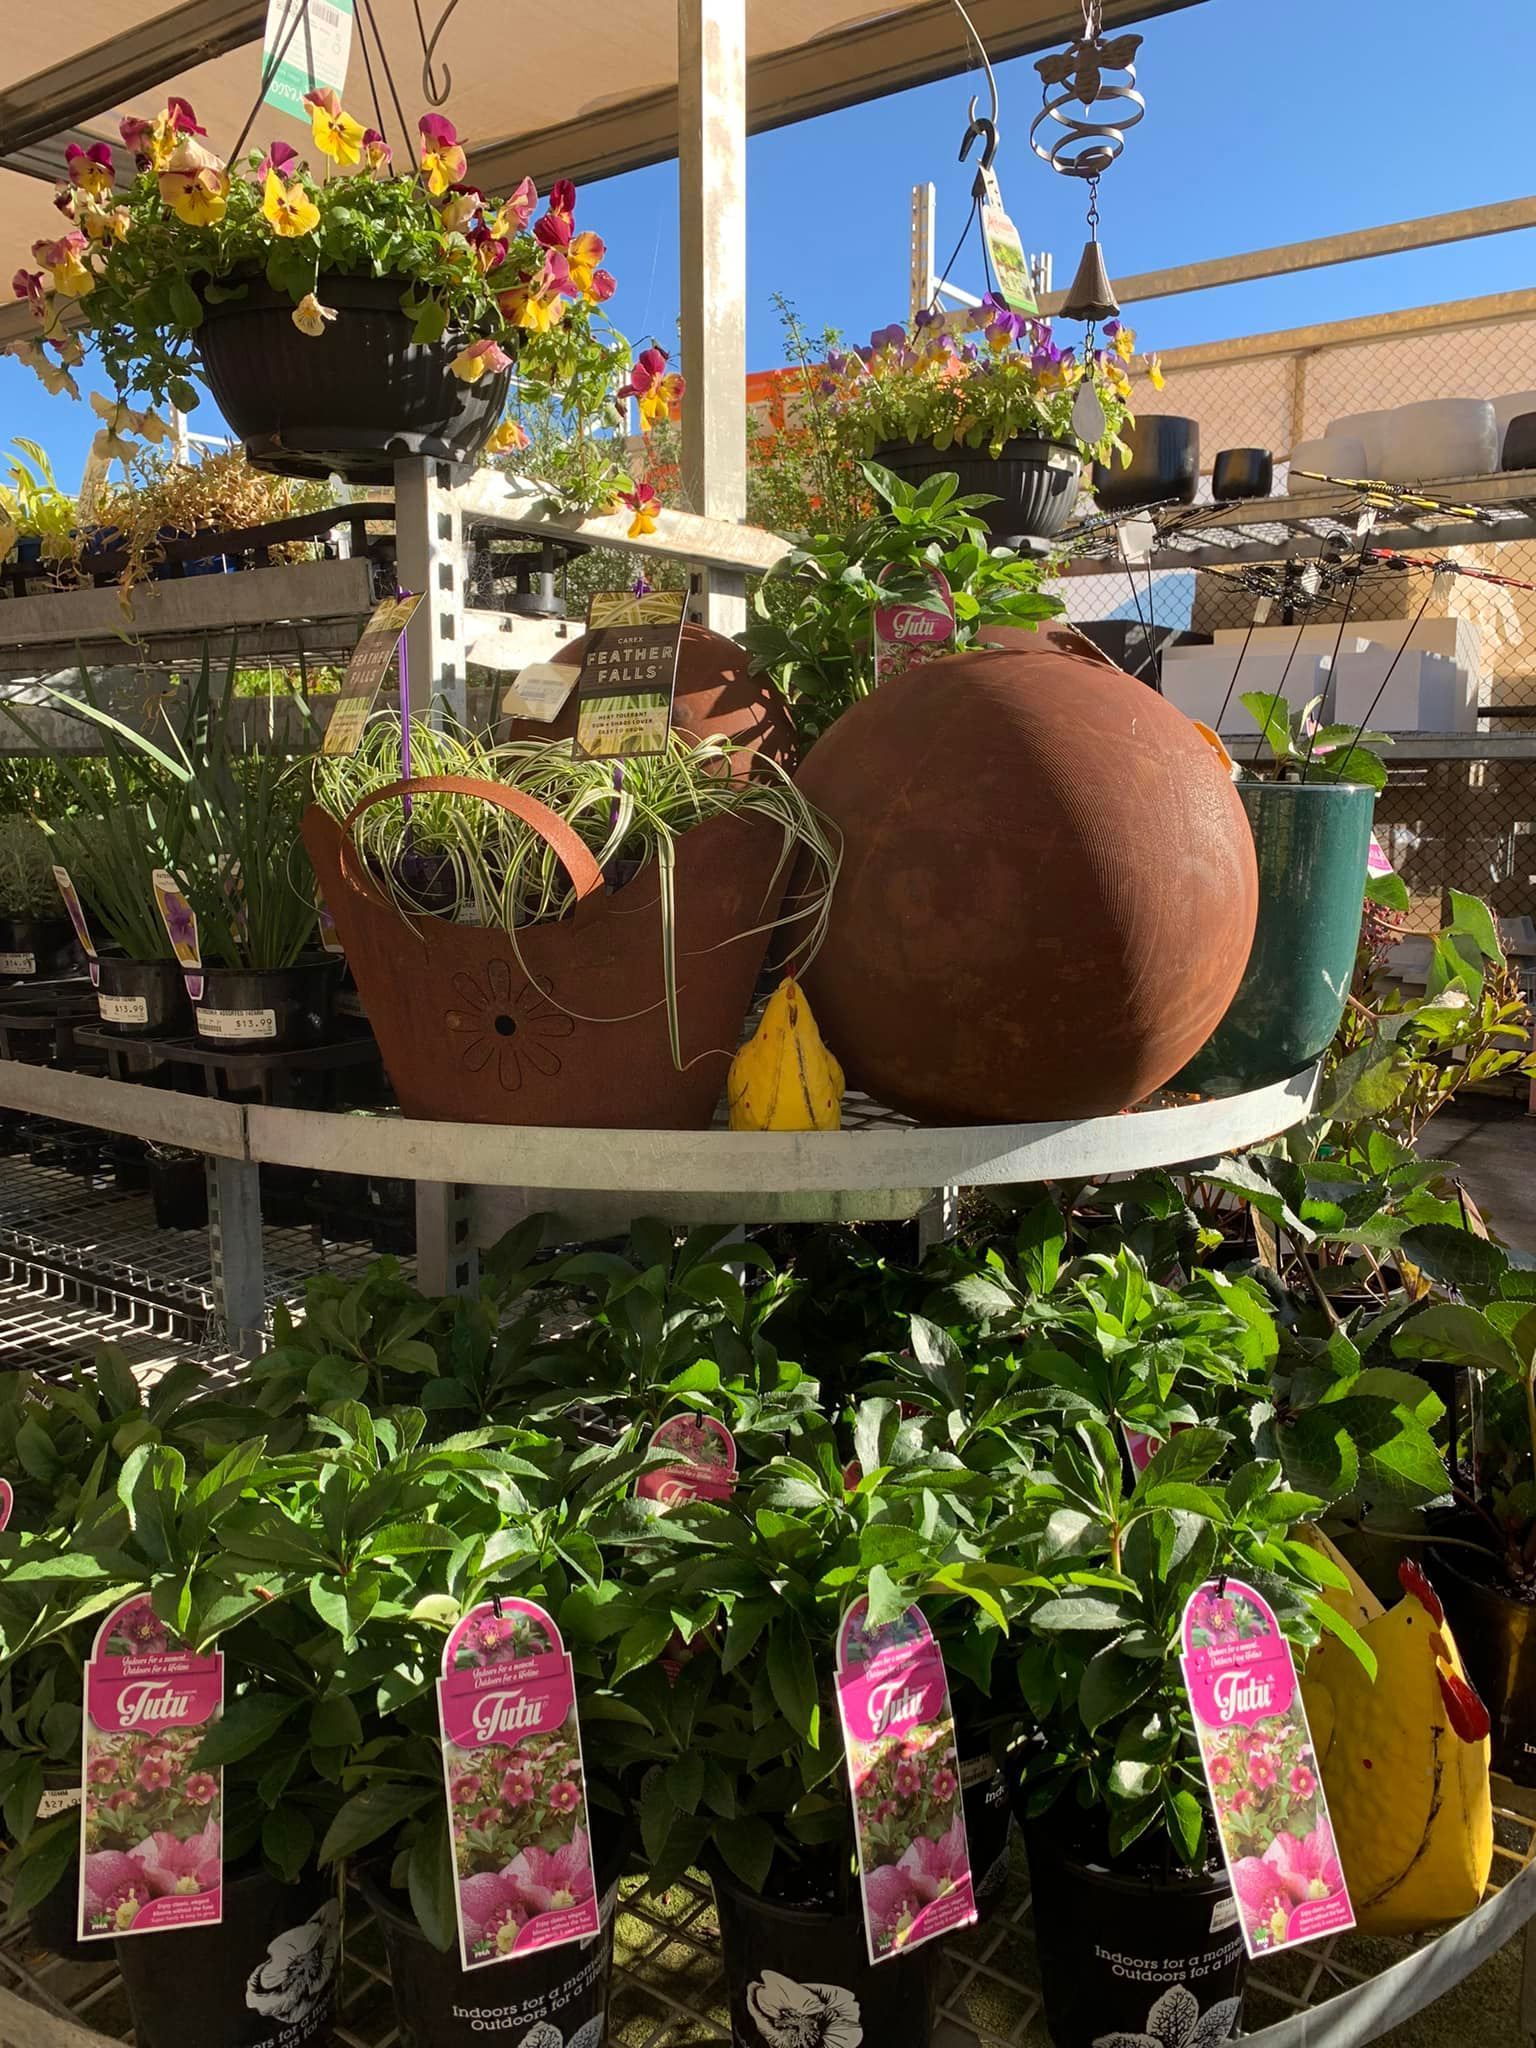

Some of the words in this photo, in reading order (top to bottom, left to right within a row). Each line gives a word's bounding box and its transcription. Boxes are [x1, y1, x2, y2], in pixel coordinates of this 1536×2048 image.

[893, 611, 935, 639] Tutu
[618, 637, 644, 645] CAREX
[587, 646, 673, 667] FEATHER
[115, 1004, 144, 1012] $13.99
[236, 1018, 272, 1028] $13.99
[117, 1680, 188, 1726] Tutu
[868, 1680, 924, 1734] Tutu
[1214, 1668, 1272, 1722] Tutu
[472, 1688, 543, 1741] Tutu
[1094, 1944, 1159, 1970] Indoors
[1163, 1958, 1184, 1970] for
[1188, 1953, 1200, 1966] a
[1111, 1964, 1187, 1983] Outdoors
[1190, 1964, 1211, 1980] for
[1212, 1960, 1222, 1971] a
[452, 2004, 518, 2019] Indoors
[522, 1995, 545, 2012] for
[548, 1986, 560, 2000] a
[471, 2006, 548, 2032] Outdoors
[551, 1993, 572, 2012] for
[574, 1986, 583, 1996] a
